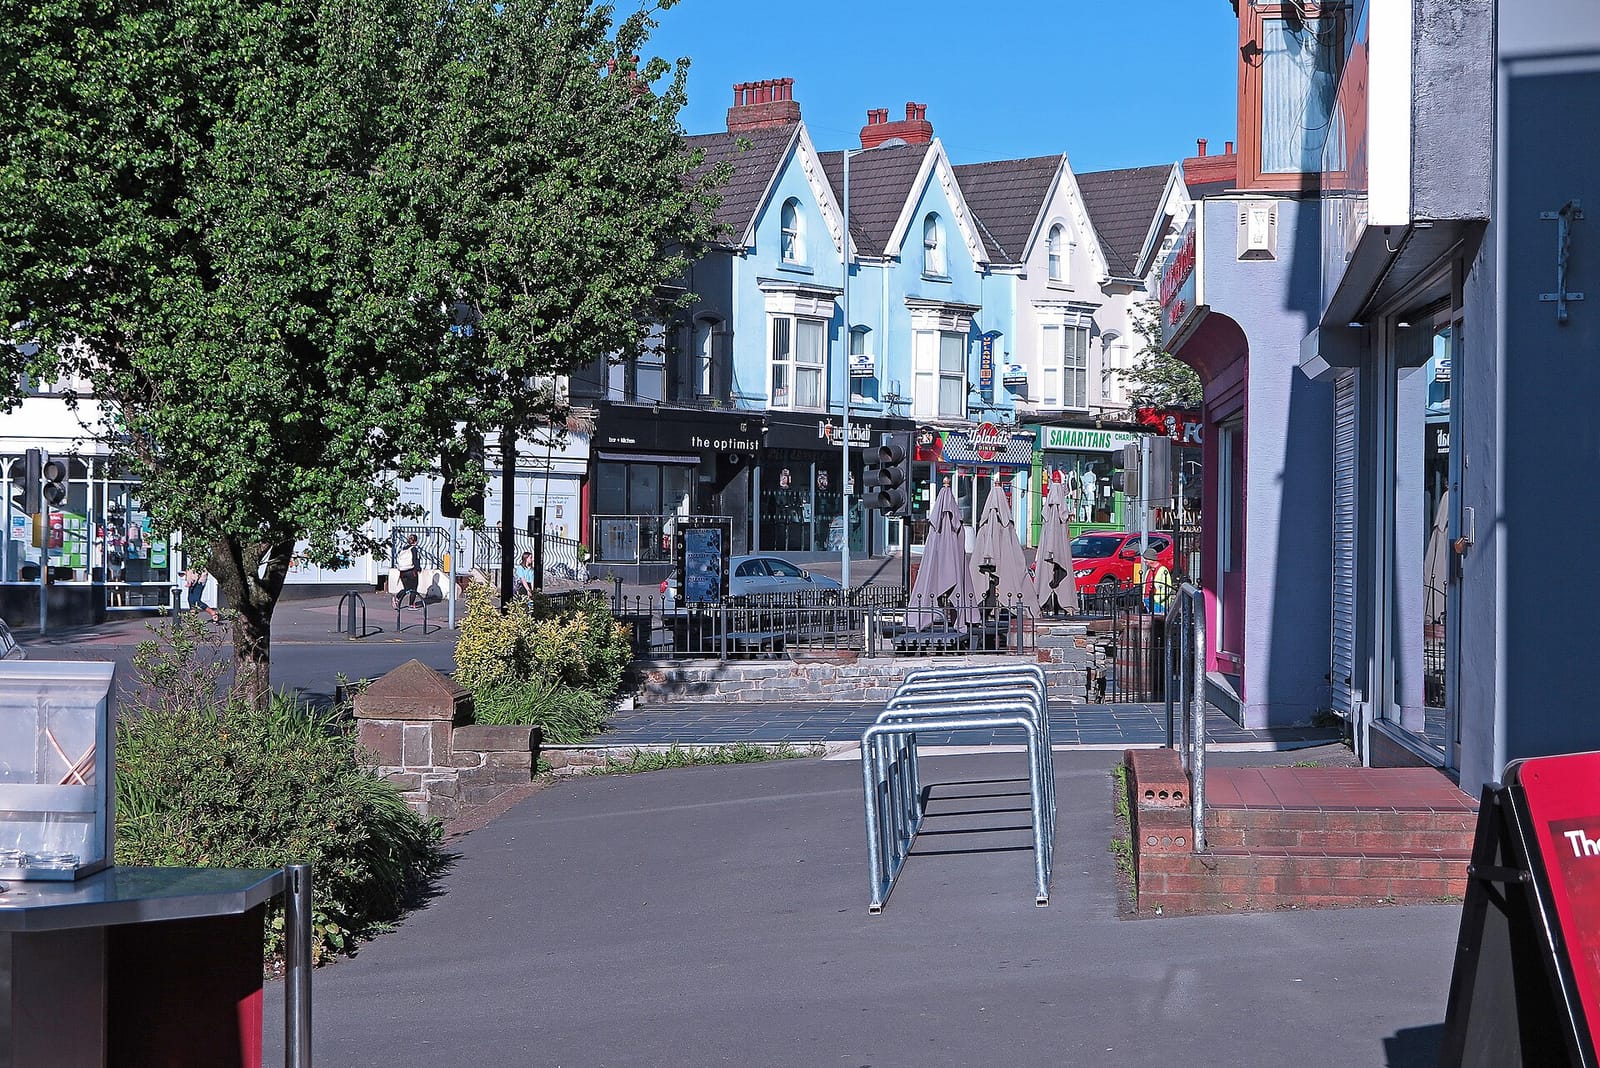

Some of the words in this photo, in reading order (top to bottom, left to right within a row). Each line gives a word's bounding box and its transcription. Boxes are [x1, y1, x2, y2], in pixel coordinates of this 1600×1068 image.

[691, 436, 710, 448] the
[713, 438, 760, 451] optimist
[967, 426, 1008, 448] Uplands
[1050, 429, 1111, 448] SAMARITANS
